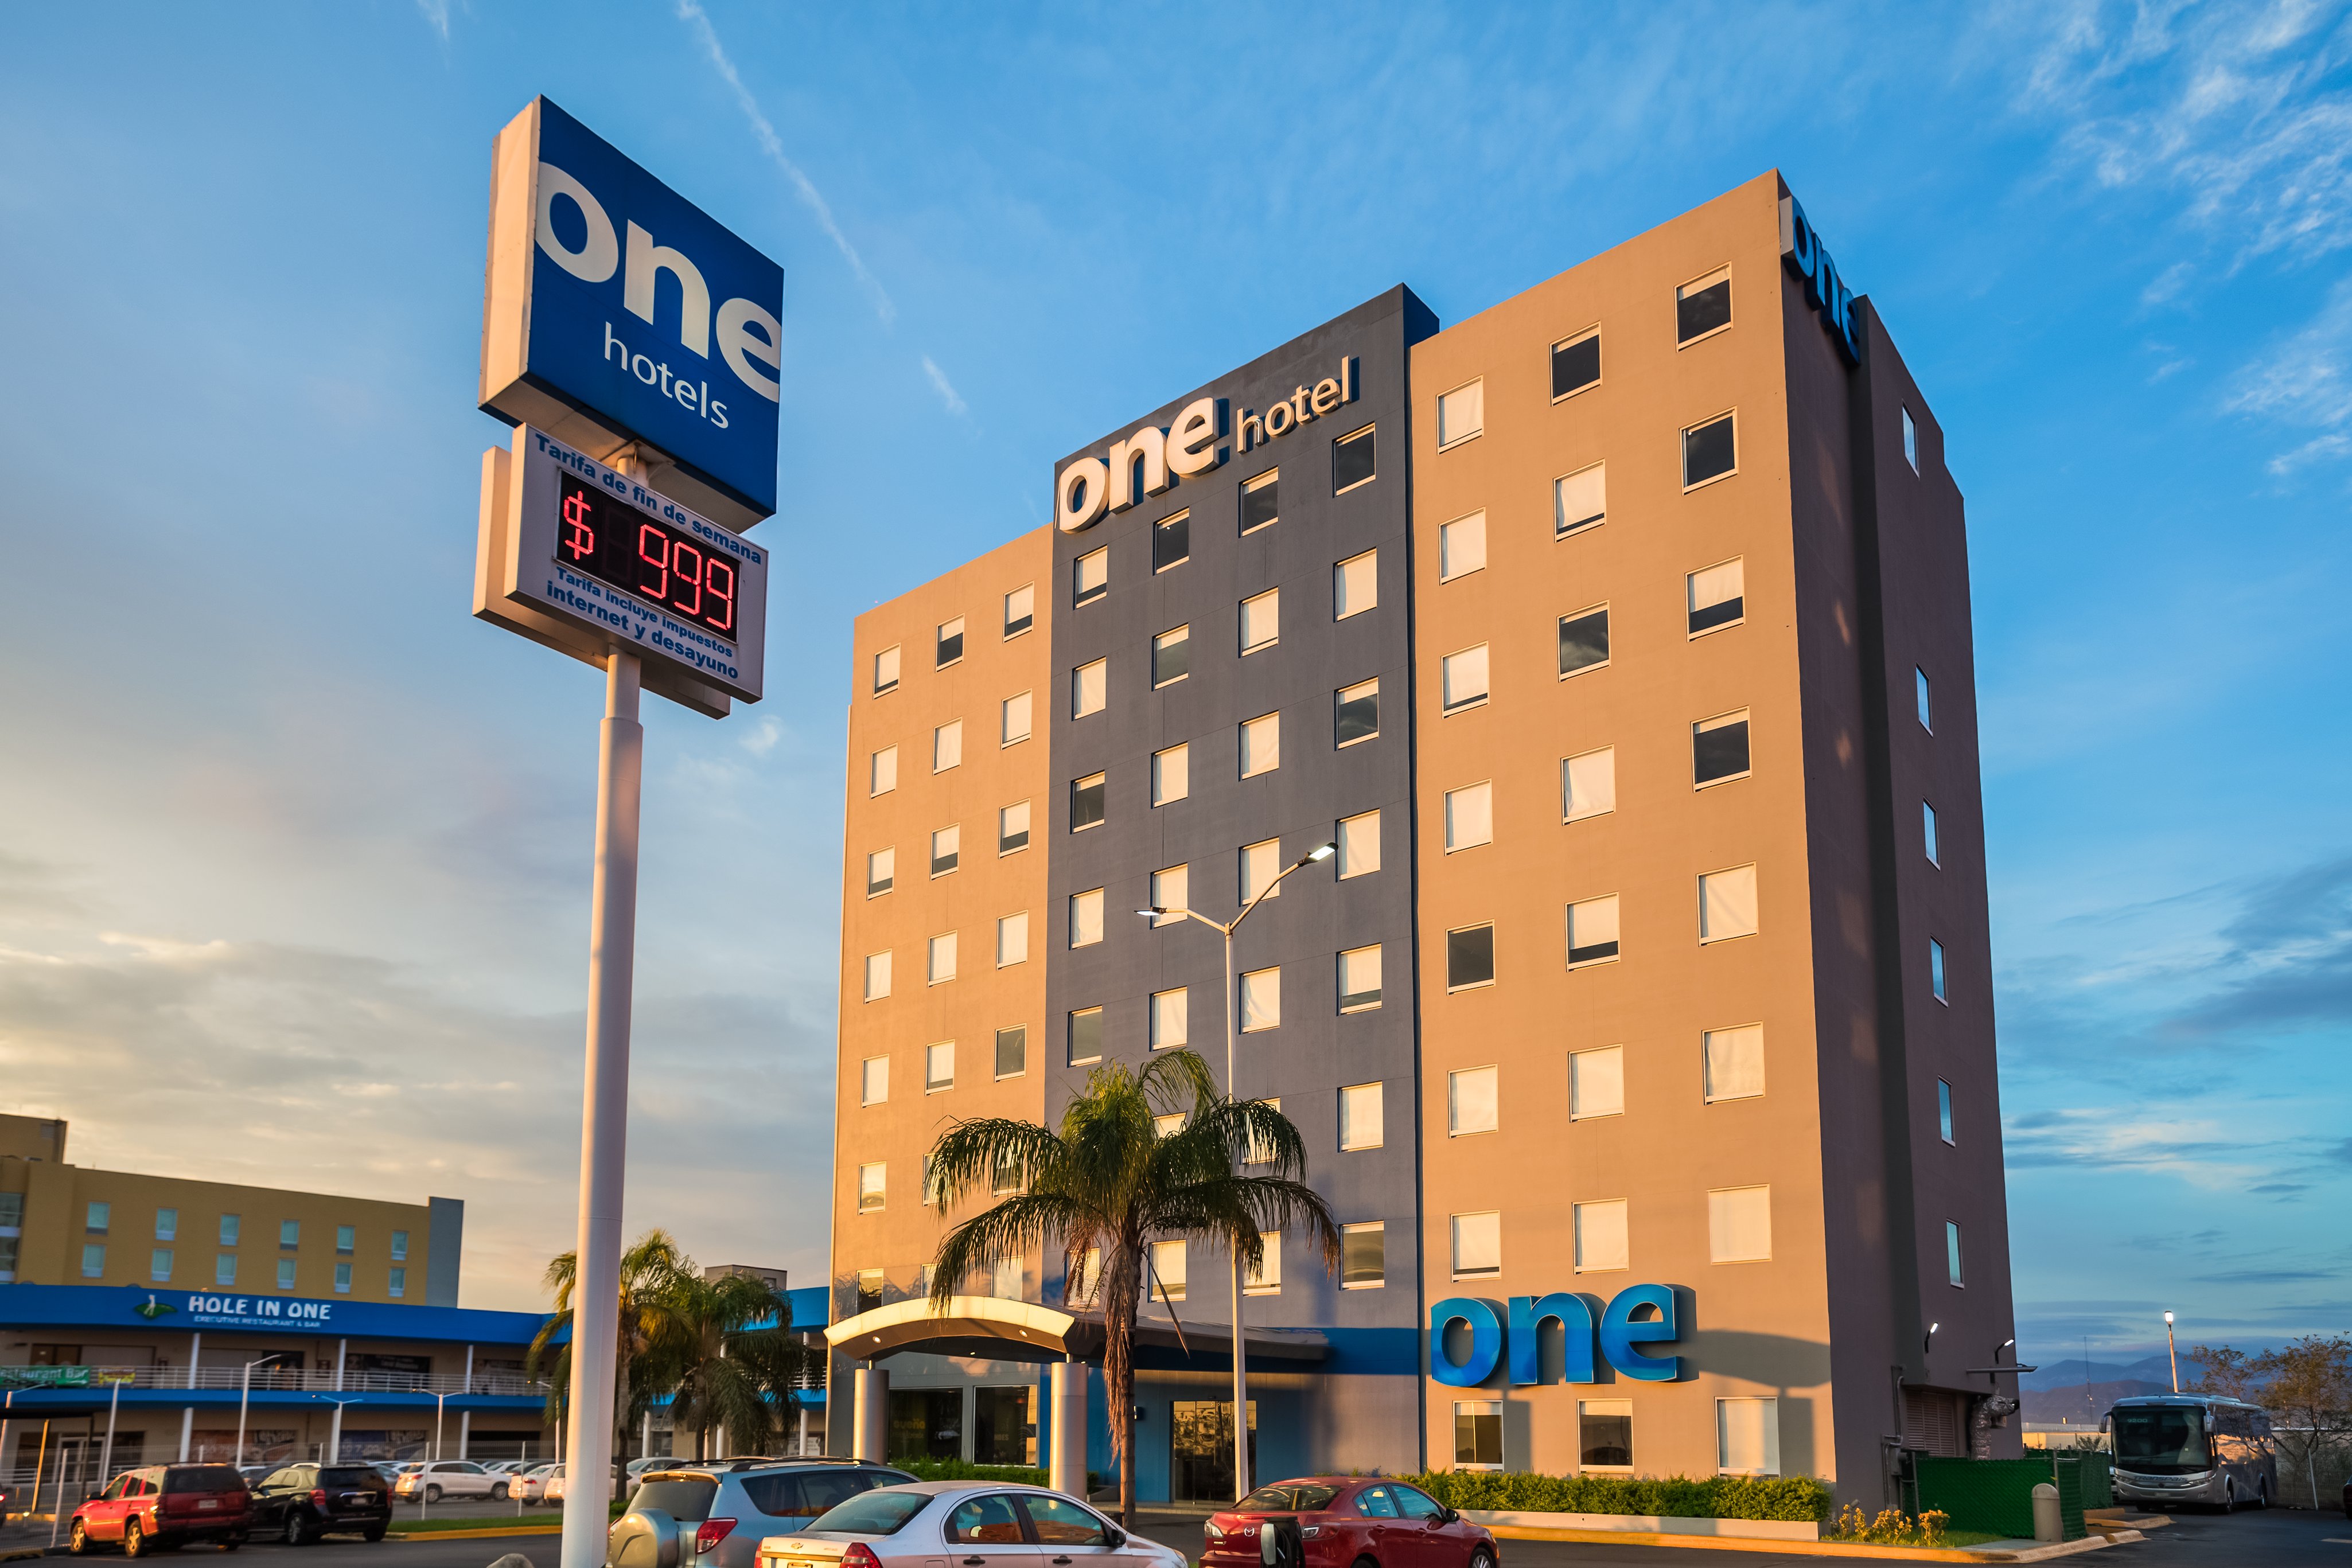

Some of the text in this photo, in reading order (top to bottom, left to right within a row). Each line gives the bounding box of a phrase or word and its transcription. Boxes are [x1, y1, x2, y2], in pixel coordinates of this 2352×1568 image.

[535, 161, 781, 403] one
[1790, 194, 1860, 365] one
[605, 321, 729, 429] hotels
[1059, 355, 1353, 533] one hotel
[535, 433, 762, 565] Tarifa de fin de semana
[556, 566, 733, 658] Tarifa incluye impuestos
[563, 490, 733, 630] $ 999
[547, 582, 738, 679] internet y desayuno
[188, 1296, 332, 1320] HOLE IN ONE
[1431, 1283, 1681, 1387] one
[0, 1368, 61, 1379] estaurant
